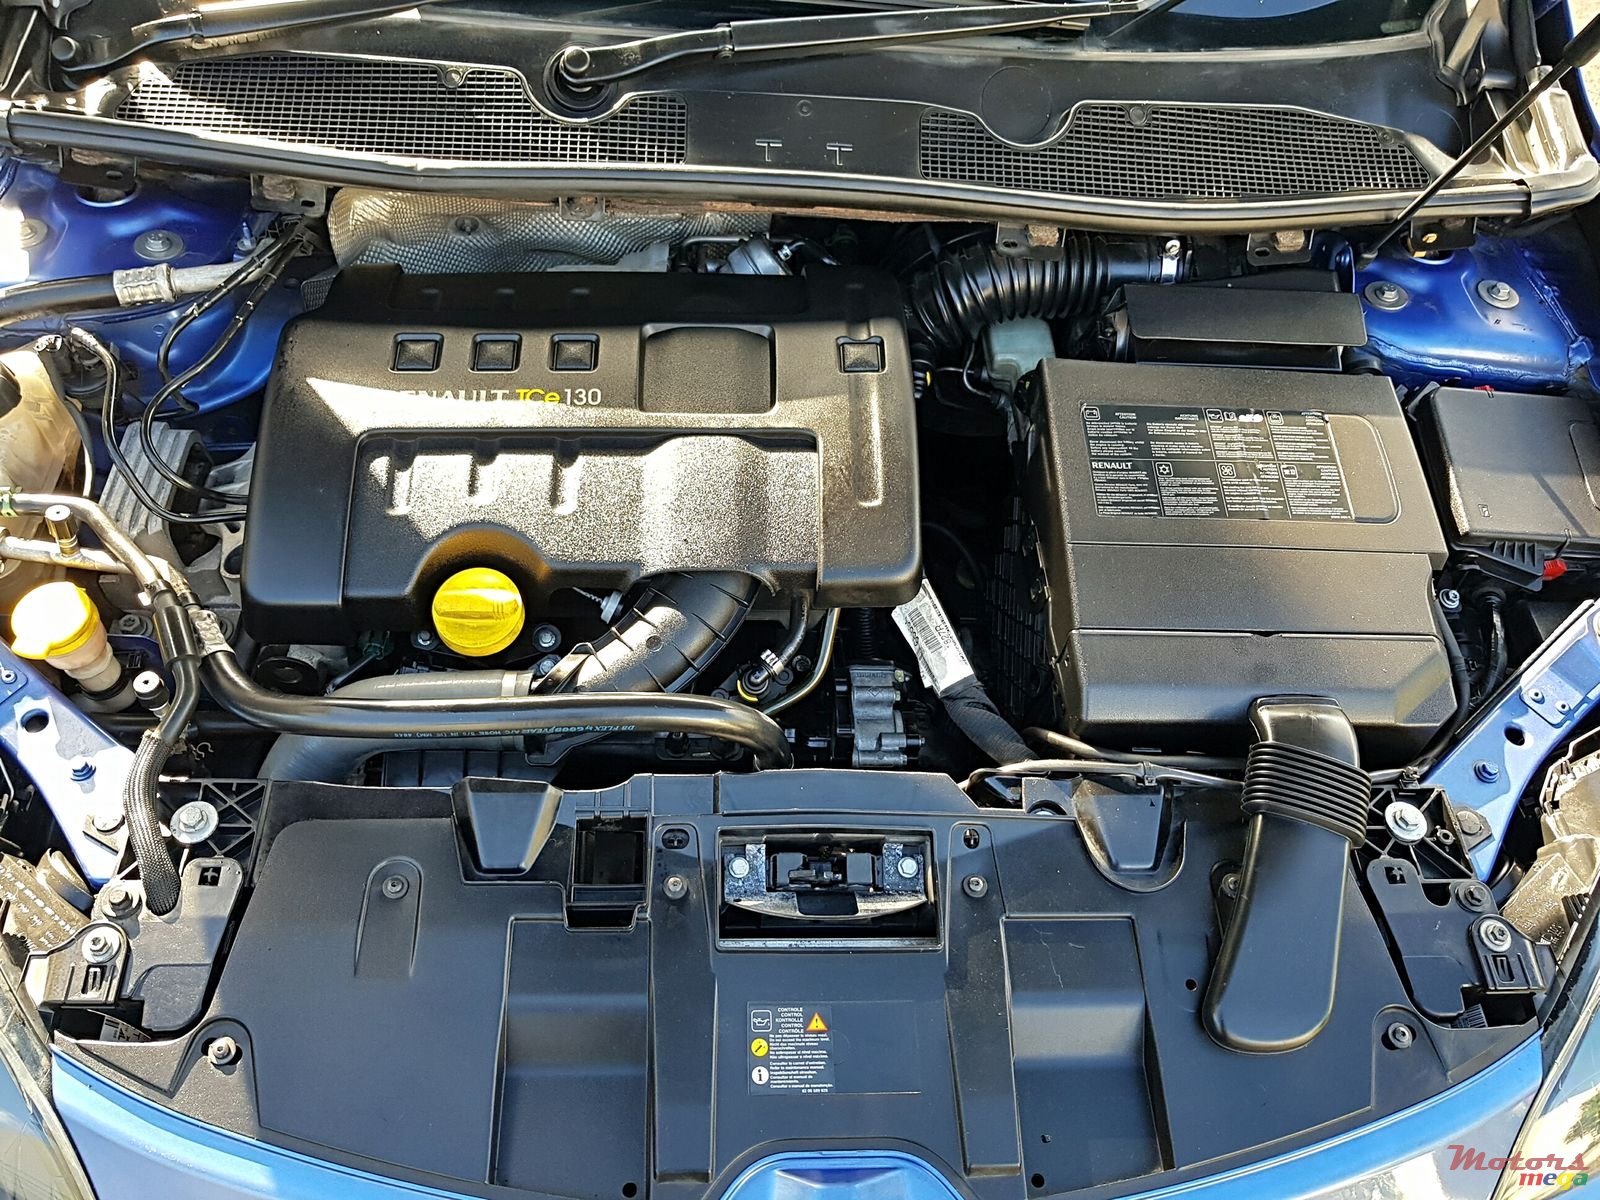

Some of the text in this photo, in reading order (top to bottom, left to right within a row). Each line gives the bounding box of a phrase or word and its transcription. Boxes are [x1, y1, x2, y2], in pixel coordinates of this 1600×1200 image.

[406, 388, 602, 406] NAULT TCe 130
[1091, 461, 1132, 469] RENAULT
